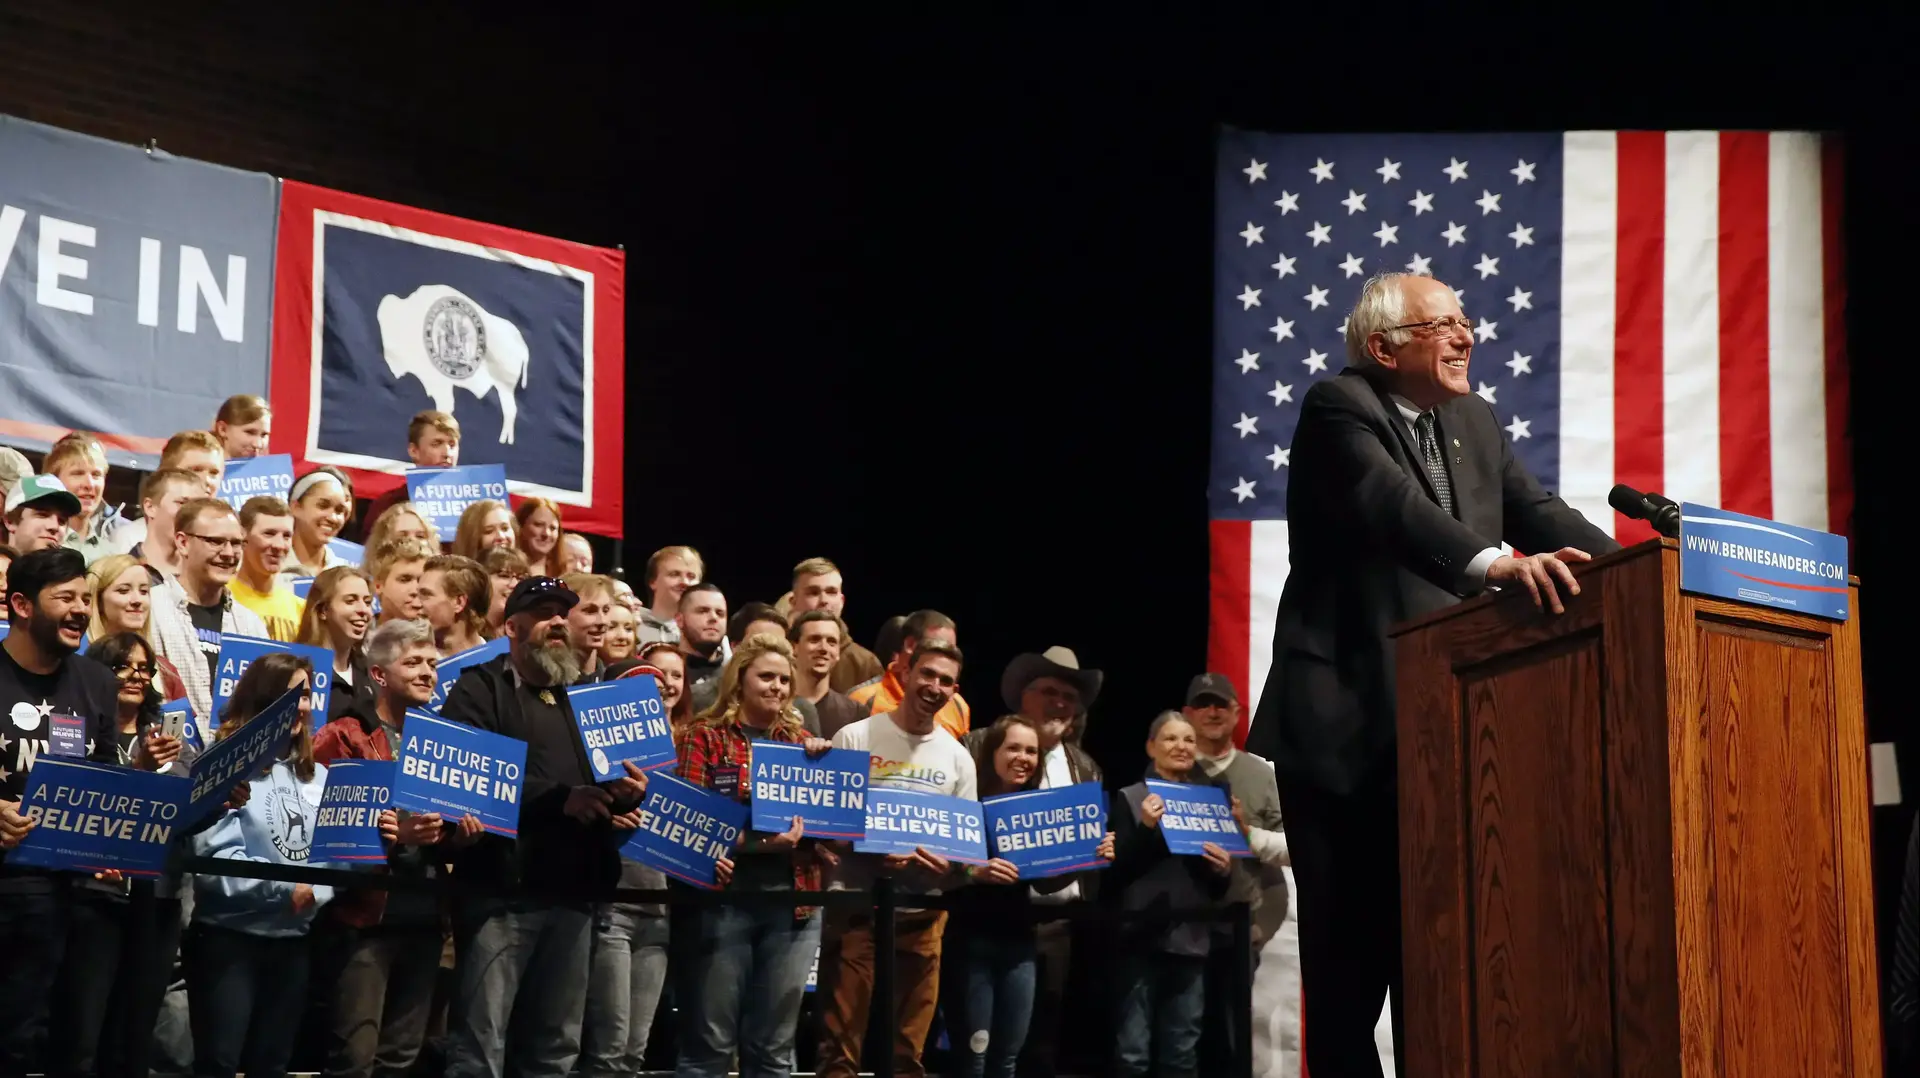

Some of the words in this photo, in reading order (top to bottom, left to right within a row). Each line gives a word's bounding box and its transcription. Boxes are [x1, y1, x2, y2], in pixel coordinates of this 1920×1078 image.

[138, 237, 247, 343] IN
[222, 475, 270, 494] UTURE
[270, 473, 292, 488] TO
[415, 486, 426, 499] A
[427, 484, 481, 499] FUTURE
[482, 482, 505, 498] TO
[1686, 534, 1844, 581] WWW.BERNIESANDERS.COM
[223, 658, 235, 675] A
[580, 711, 589, 727] A
[588, 702, 639, 725] FUTURE
[639, 698, 660, 716] TO
[584, 721, 646, 749] BELIEVE
[646, 717, 668, 738] IN
[189, 735, 271, 805] BELIEVE
[273, 716, 293, 742] IN
[208, 720, 275, 776] FUTURE
[406, 735, 419, 753] A
[423, 739, 491, 773] FUTURE
[495, 759, 519, 780] TO
[402, 755, 490, 796] BELIEVE
[493, 780, 517, 804] IN
[757, 763, 768, 778] A
[771, 764, 836, 786] FUTURE
[840, 771, 865, 788] TO
[32, 783, 48, 801] A
[53, 786, 144, 816] FUTURE
[150, 800, 178, 820] TO
[322, 786, 330, 802] A
[330, 785, 369, 802] FUTURE
[371, 786, 390, 804] TO
[756, 781, 835, 807] BELIEVE
[840, 791, 864, 810] IN
[1165, 799, 1213, 817] FUTURE
[1210, 803, 1230, 818] TO
[25, 805, 138, 840] BELIEVE
[139, 823, 172, 845] IN
[316, 807, 366, 827] BELIEVE
[648, 792, 717, 833] FUTURE
[717, 821, 737, 841] TO
[876, 802, 949, 822] FUTURE
[952, 812, 980, 827] TO
[995, 817, 1008, 832] A
[1010, 807, 1074, 830] FUTURE
[1075, 803, 1100, 820] TO
[1161, 814, 1220, 833] BELIEVE
[1218, 819, 1239, 834] IN
[638, 810, 708, 853] ELIEVE
[706, 840, 730, 860] IN
[956, 827, 981, 844] IN
[996, 825, 1076, 853] BELIEVE
[1079, 821, 1102, 840] IN
